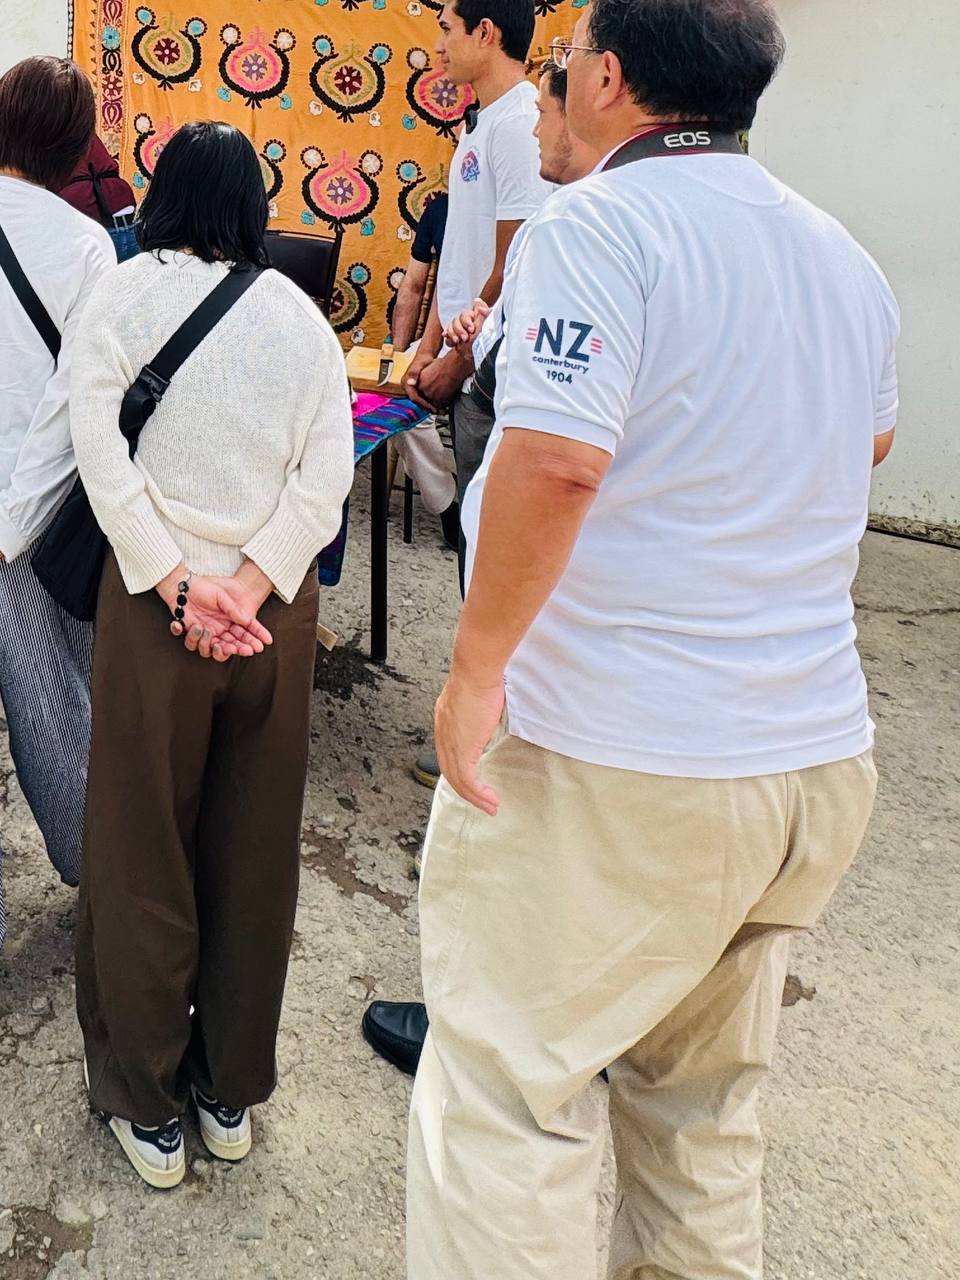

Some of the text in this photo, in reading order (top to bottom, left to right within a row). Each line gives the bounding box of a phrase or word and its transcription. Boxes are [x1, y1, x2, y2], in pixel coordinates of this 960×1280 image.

[663, 131, 711, 148] EOS
[534, 317, 594, 363] NZ
[532, 355, 589, 375] canterbury
[546, 370, 573, 384] 1904
